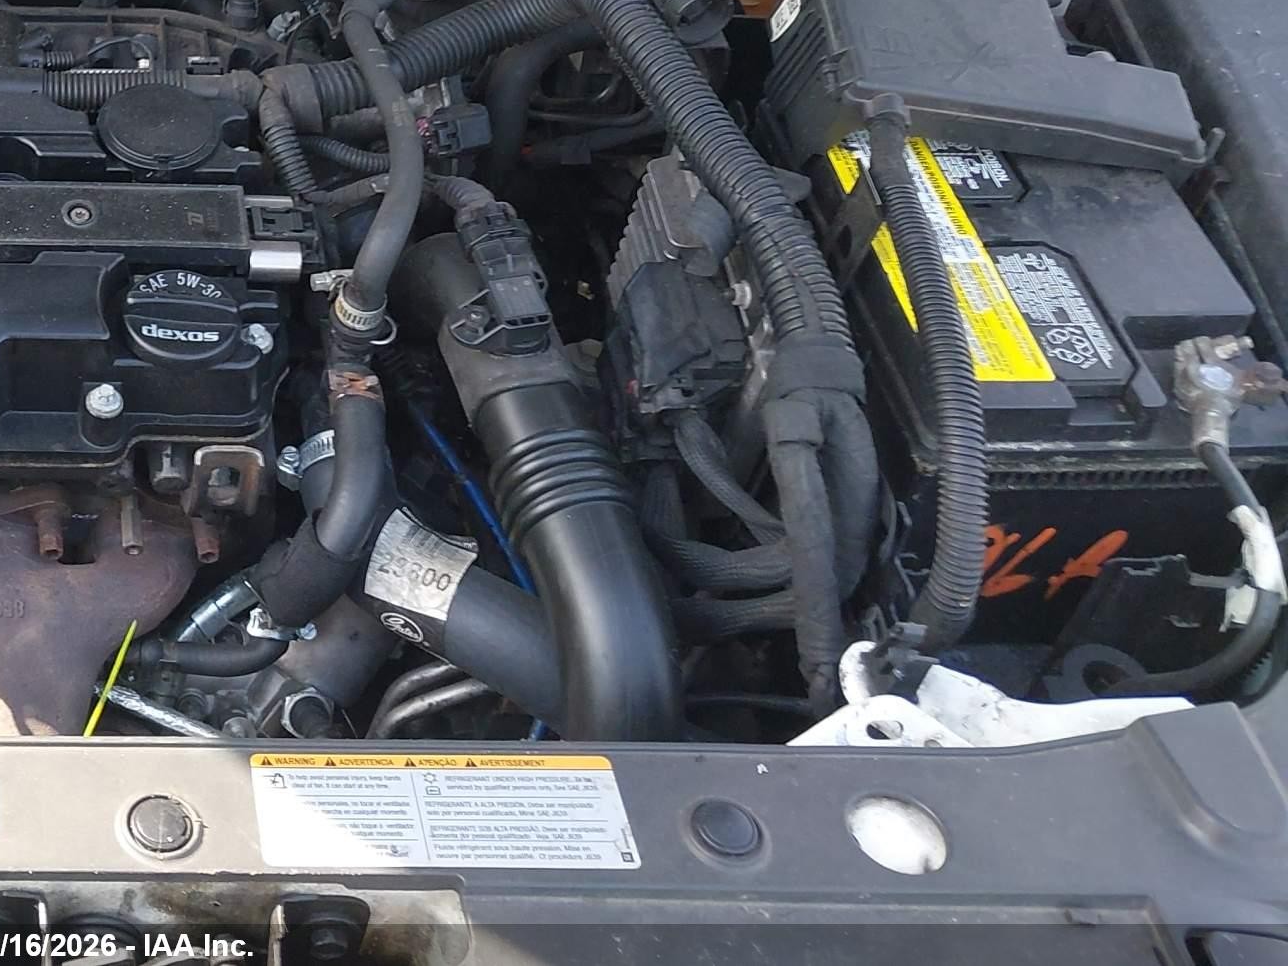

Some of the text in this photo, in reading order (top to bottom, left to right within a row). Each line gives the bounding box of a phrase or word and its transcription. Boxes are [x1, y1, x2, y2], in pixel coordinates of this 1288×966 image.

[139, 273, 169, 294] SAE
[141, 323, 221, 343] dexos
[274, 757, 316, 766] WARNING
